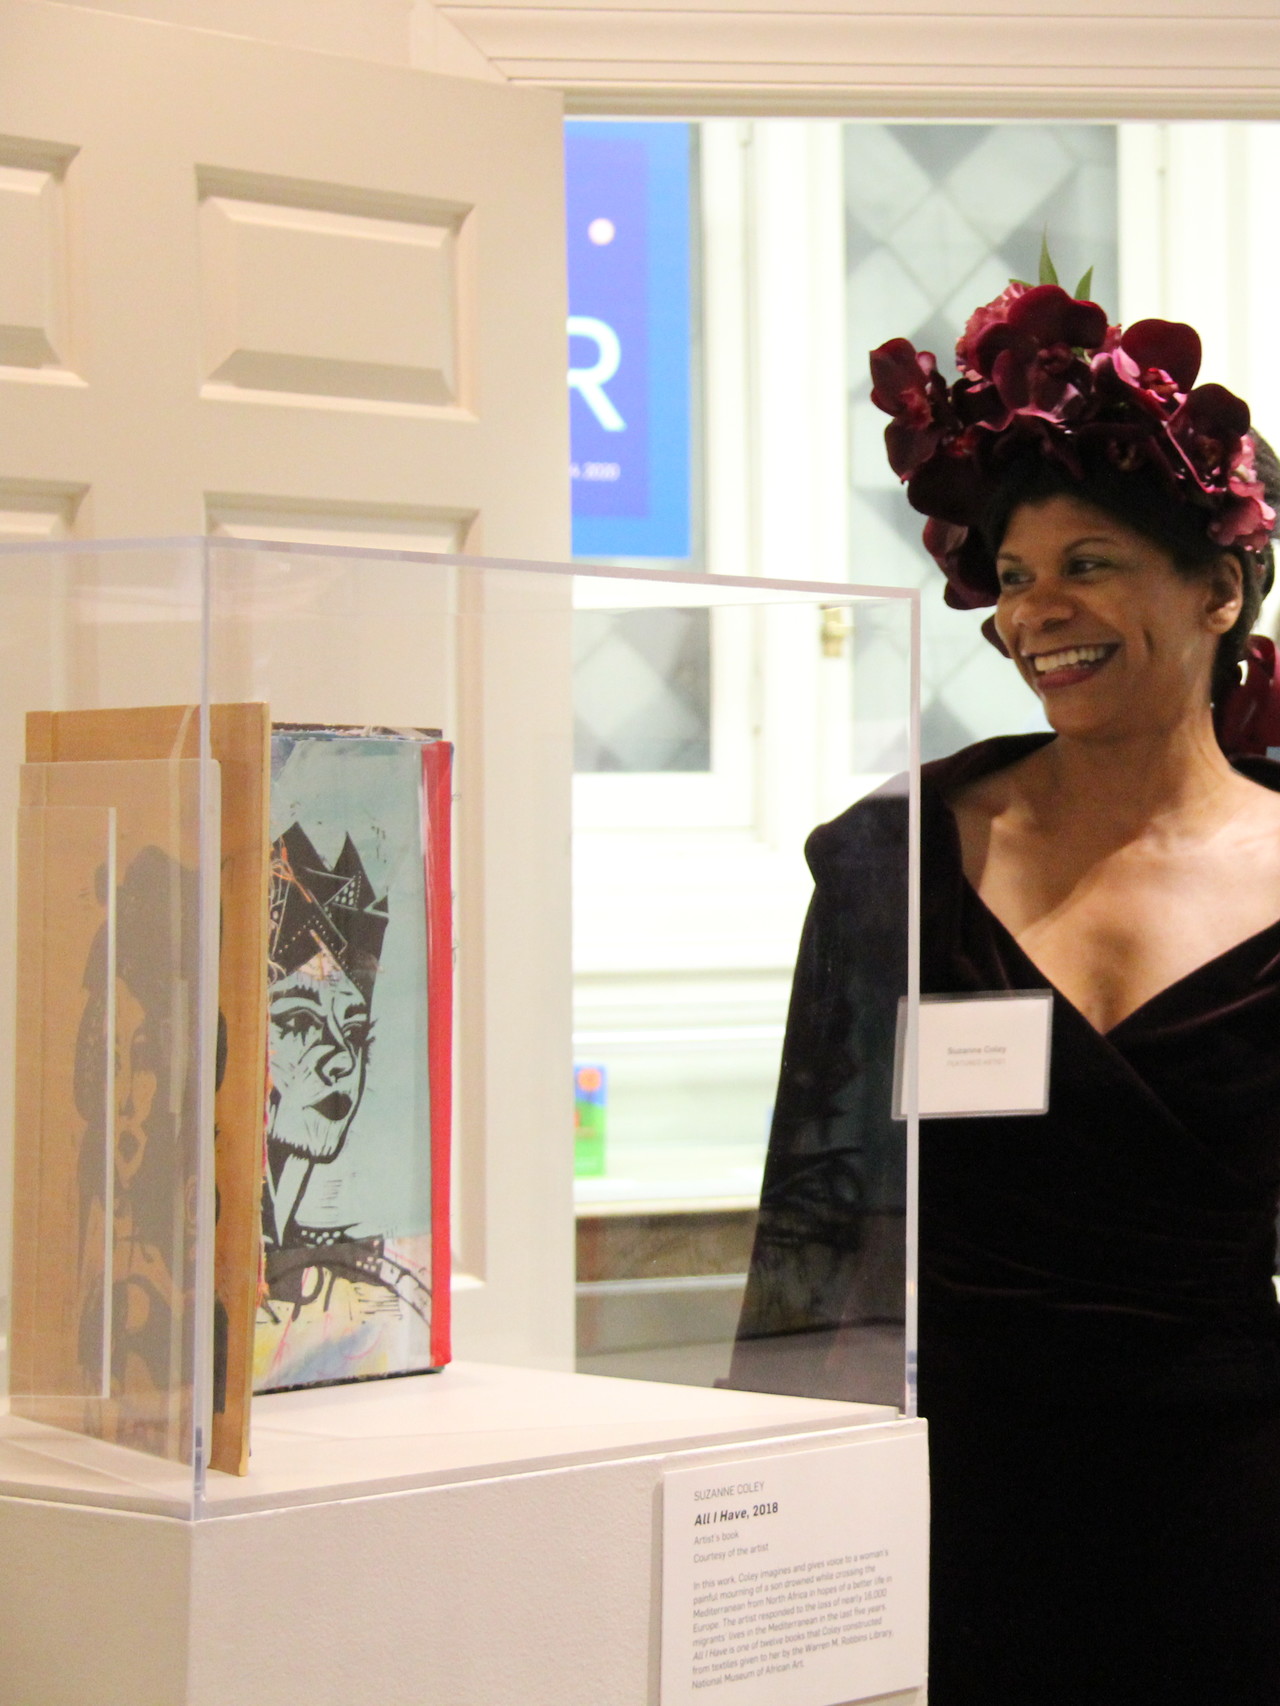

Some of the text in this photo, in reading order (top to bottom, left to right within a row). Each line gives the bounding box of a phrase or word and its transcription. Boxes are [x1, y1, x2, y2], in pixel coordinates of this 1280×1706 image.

[694, 1481, 764, 1501] SUZANNE COLEY
[694, 1502, 778, 1526] All I Have, 2018
[722, 1529, 739, 1541] book
[693, 1543, 768, 1563] Courtesy of the artist
[693, 1593, 718, 1605] painful
[720, 1588, 754, 1598] mourning
[785, 1576, 814, 1588] drowned
[816, 1573, 833, 1582] while
[836, 1568, 863, 1578] crossing
[702, 1580, 715, 1589] this
[738, 1573, 758, 1583] Coley
[760, 1567, 791, 1578] imagines
[807, 1562, 825, 1574] gives
[827, 1558, 843, 1566] voice
[693, 1603, 745, 1618] Mediterranean
[748, 1600, 764, 1608] from
[766, 1595, 785, 1605] North
[788, 1592, 807, 1600] Africa
[817, 1586, 837, 1595] hopes
[853, 1580, 872, 1589] better
[738, 1614, 756, 1624] artist
[758, 1606, 795, 1619] responded
[818, 1601, 831, 1609] loss
[842, 1595, 862, 1604] nearly
[709, 1648, 727, 1657] Have
[760, 1638, 783, 1647] twelve
[785, 1633, 805, 1643] books
[807, 1629, 820, 1638] that
[823, 1626, 841, 1635] Coley
[843, 1617, 882, 1631] constructed
[729, 1631, 744, 1640] lives
[768, 1617, 817, 1632] Mediterranean
[693, 1665, 710, 1674] from
[712, 1660, 737, 1671] textiles
[740, 1656, 758, 1668] given
[805, 1642, 830, 1652] Warren
[841, 1634, 868, 1645] Robbins
[692, 1675, 722, 1689] National
[725, 1671, 754, 1682] Museum
[766, 1664, 790, 1675] African
